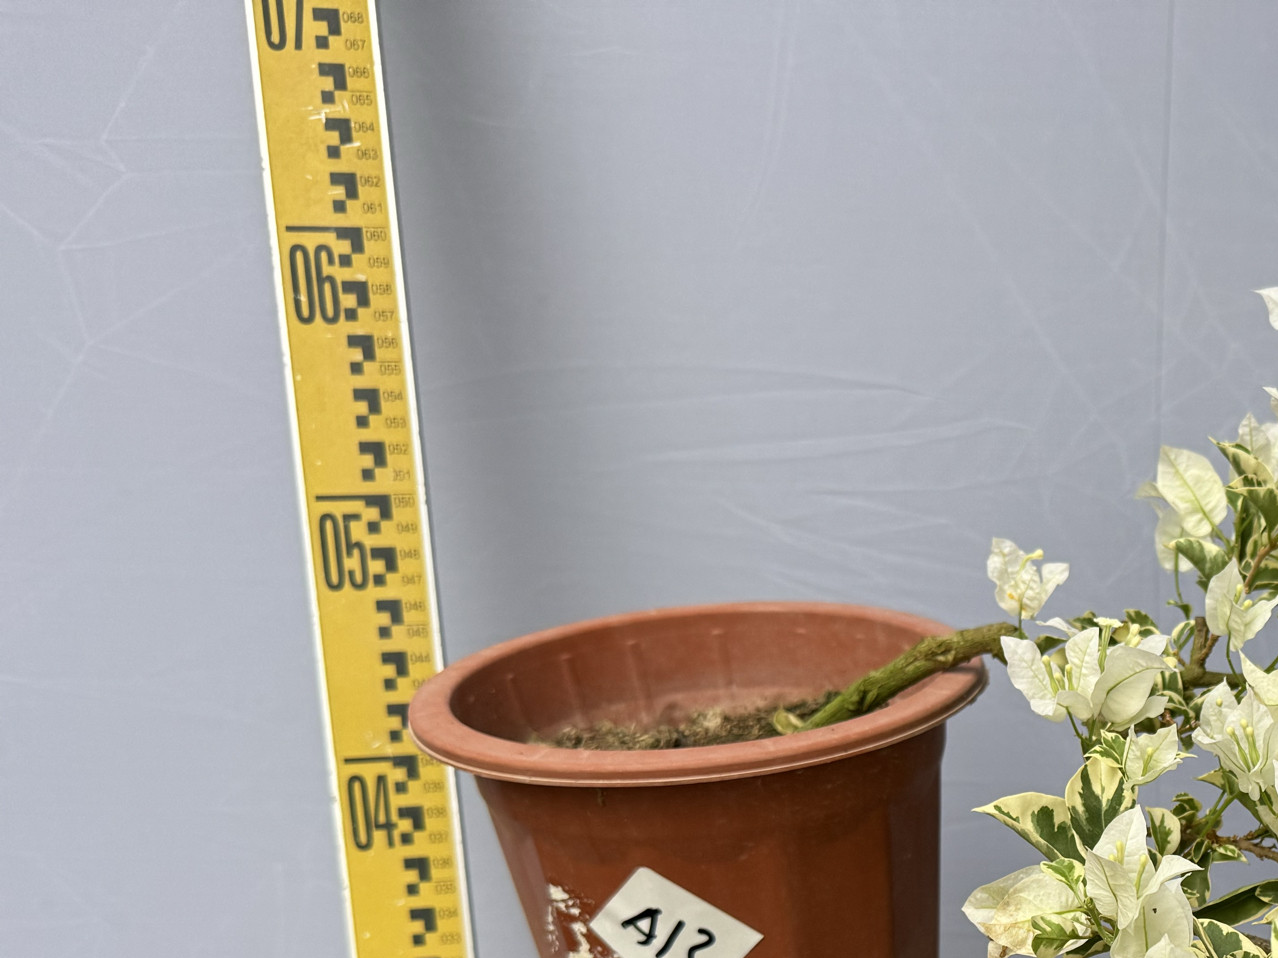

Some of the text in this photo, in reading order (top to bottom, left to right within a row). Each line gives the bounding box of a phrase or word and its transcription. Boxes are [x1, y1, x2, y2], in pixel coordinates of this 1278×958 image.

[290, 244, 341, 325] 06
[320, 513, 369, 592] 05
[348, 775, 397, 851] 04
